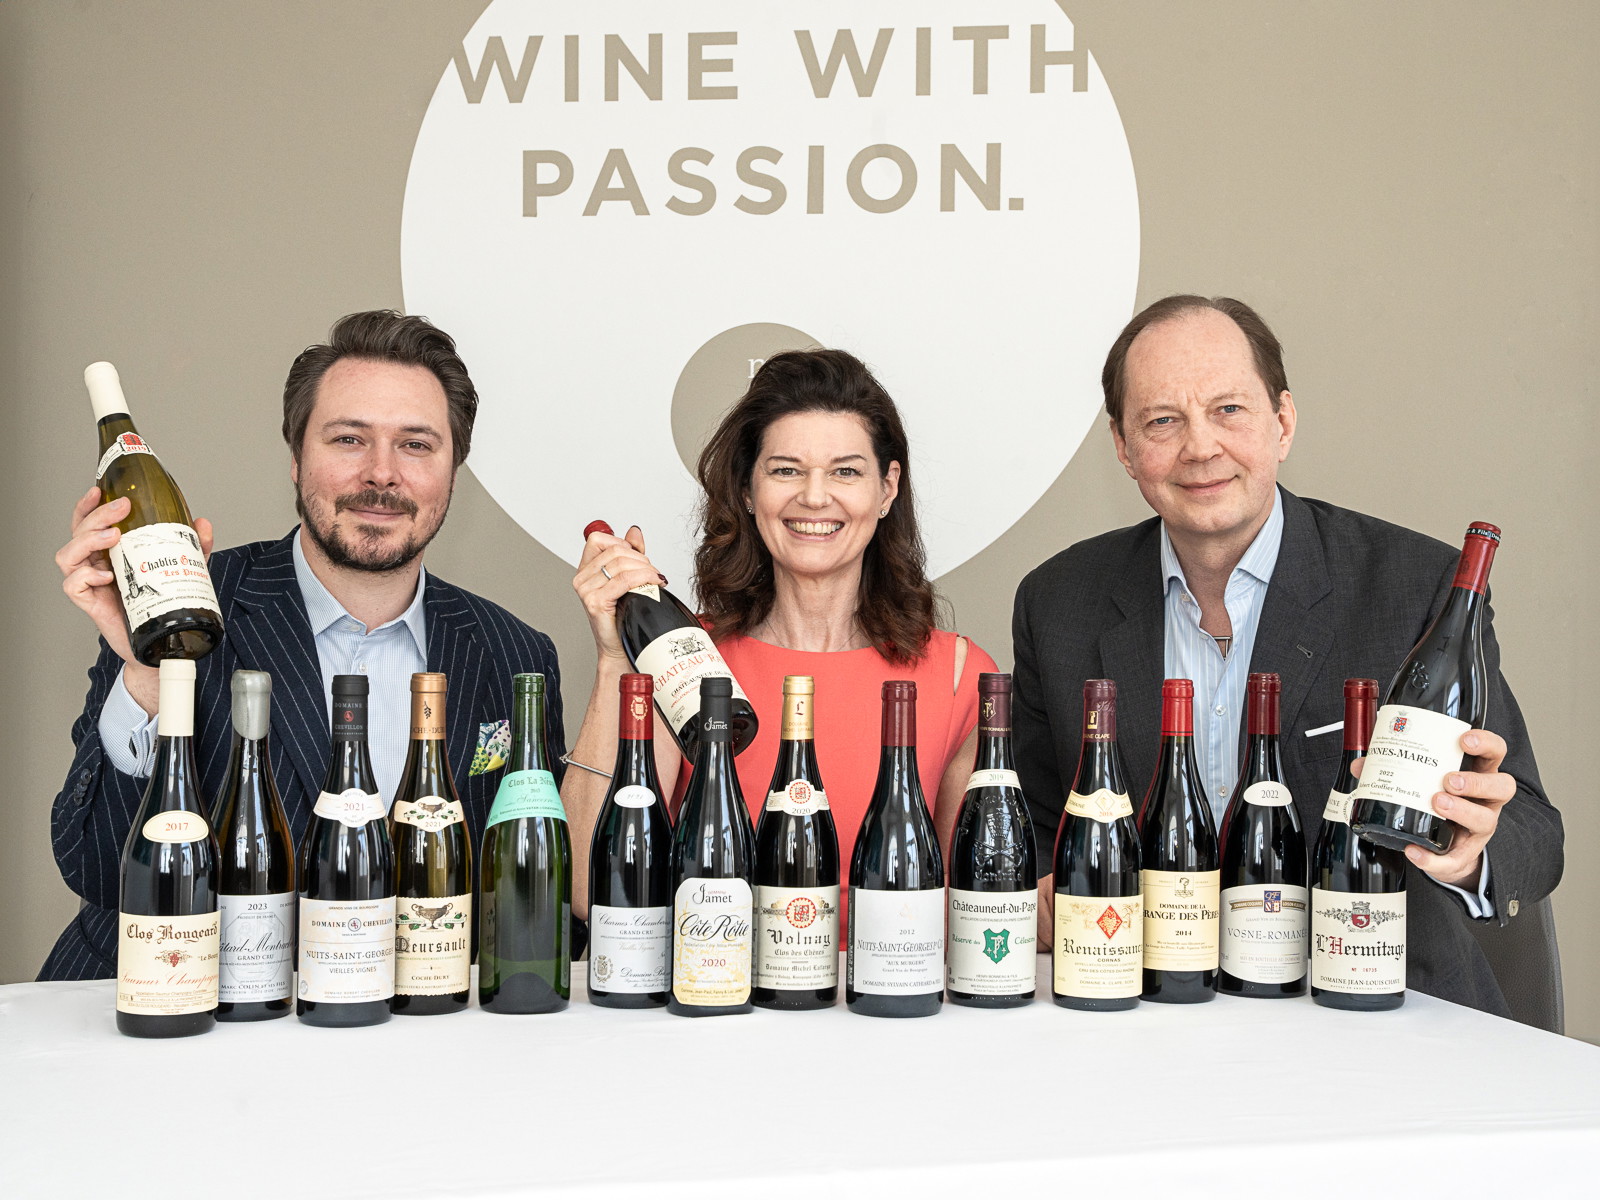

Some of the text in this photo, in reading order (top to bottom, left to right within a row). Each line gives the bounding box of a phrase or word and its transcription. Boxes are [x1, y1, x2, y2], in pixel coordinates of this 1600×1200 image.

[453, 24, 1089, 104] WINE WITH
[522, 142, 1024, 217] PASSION.
[140, 557, 179, 573] Chablis
[704, 716, 728, 732] Jamet
[989, 773, 1004, 781] 2019
[1379, 769, 1394, 777] 2022
[1261, 789, 1279, 799] 2022
[343, 803, 365, 812] 2021
[165, 822, 189, 832] 2017
[692, 883, 733, 905] Jamet
[247, 903, 268, 911] 2023
[1179, 912, 1198, 920] DES
[312, 920, 347, 928] DOMAINE
[363, 918, 393, 927] CHEVILLON
[127, 921, 218, 945] Clos Rougeard
[767, 928, 831, 949] Volnay
[774, 948, 790, 956] Clos
[1315, 933, 1405, 961] L'Hermitage
[701, 958, 727, 968] 2020
[765, 963, 790, 972] Domaine
[792, 964, 812, 972] Michel
[620, 967, 654, 978] Domaine
[1320, 975, 1347, 985] DOMAINE
